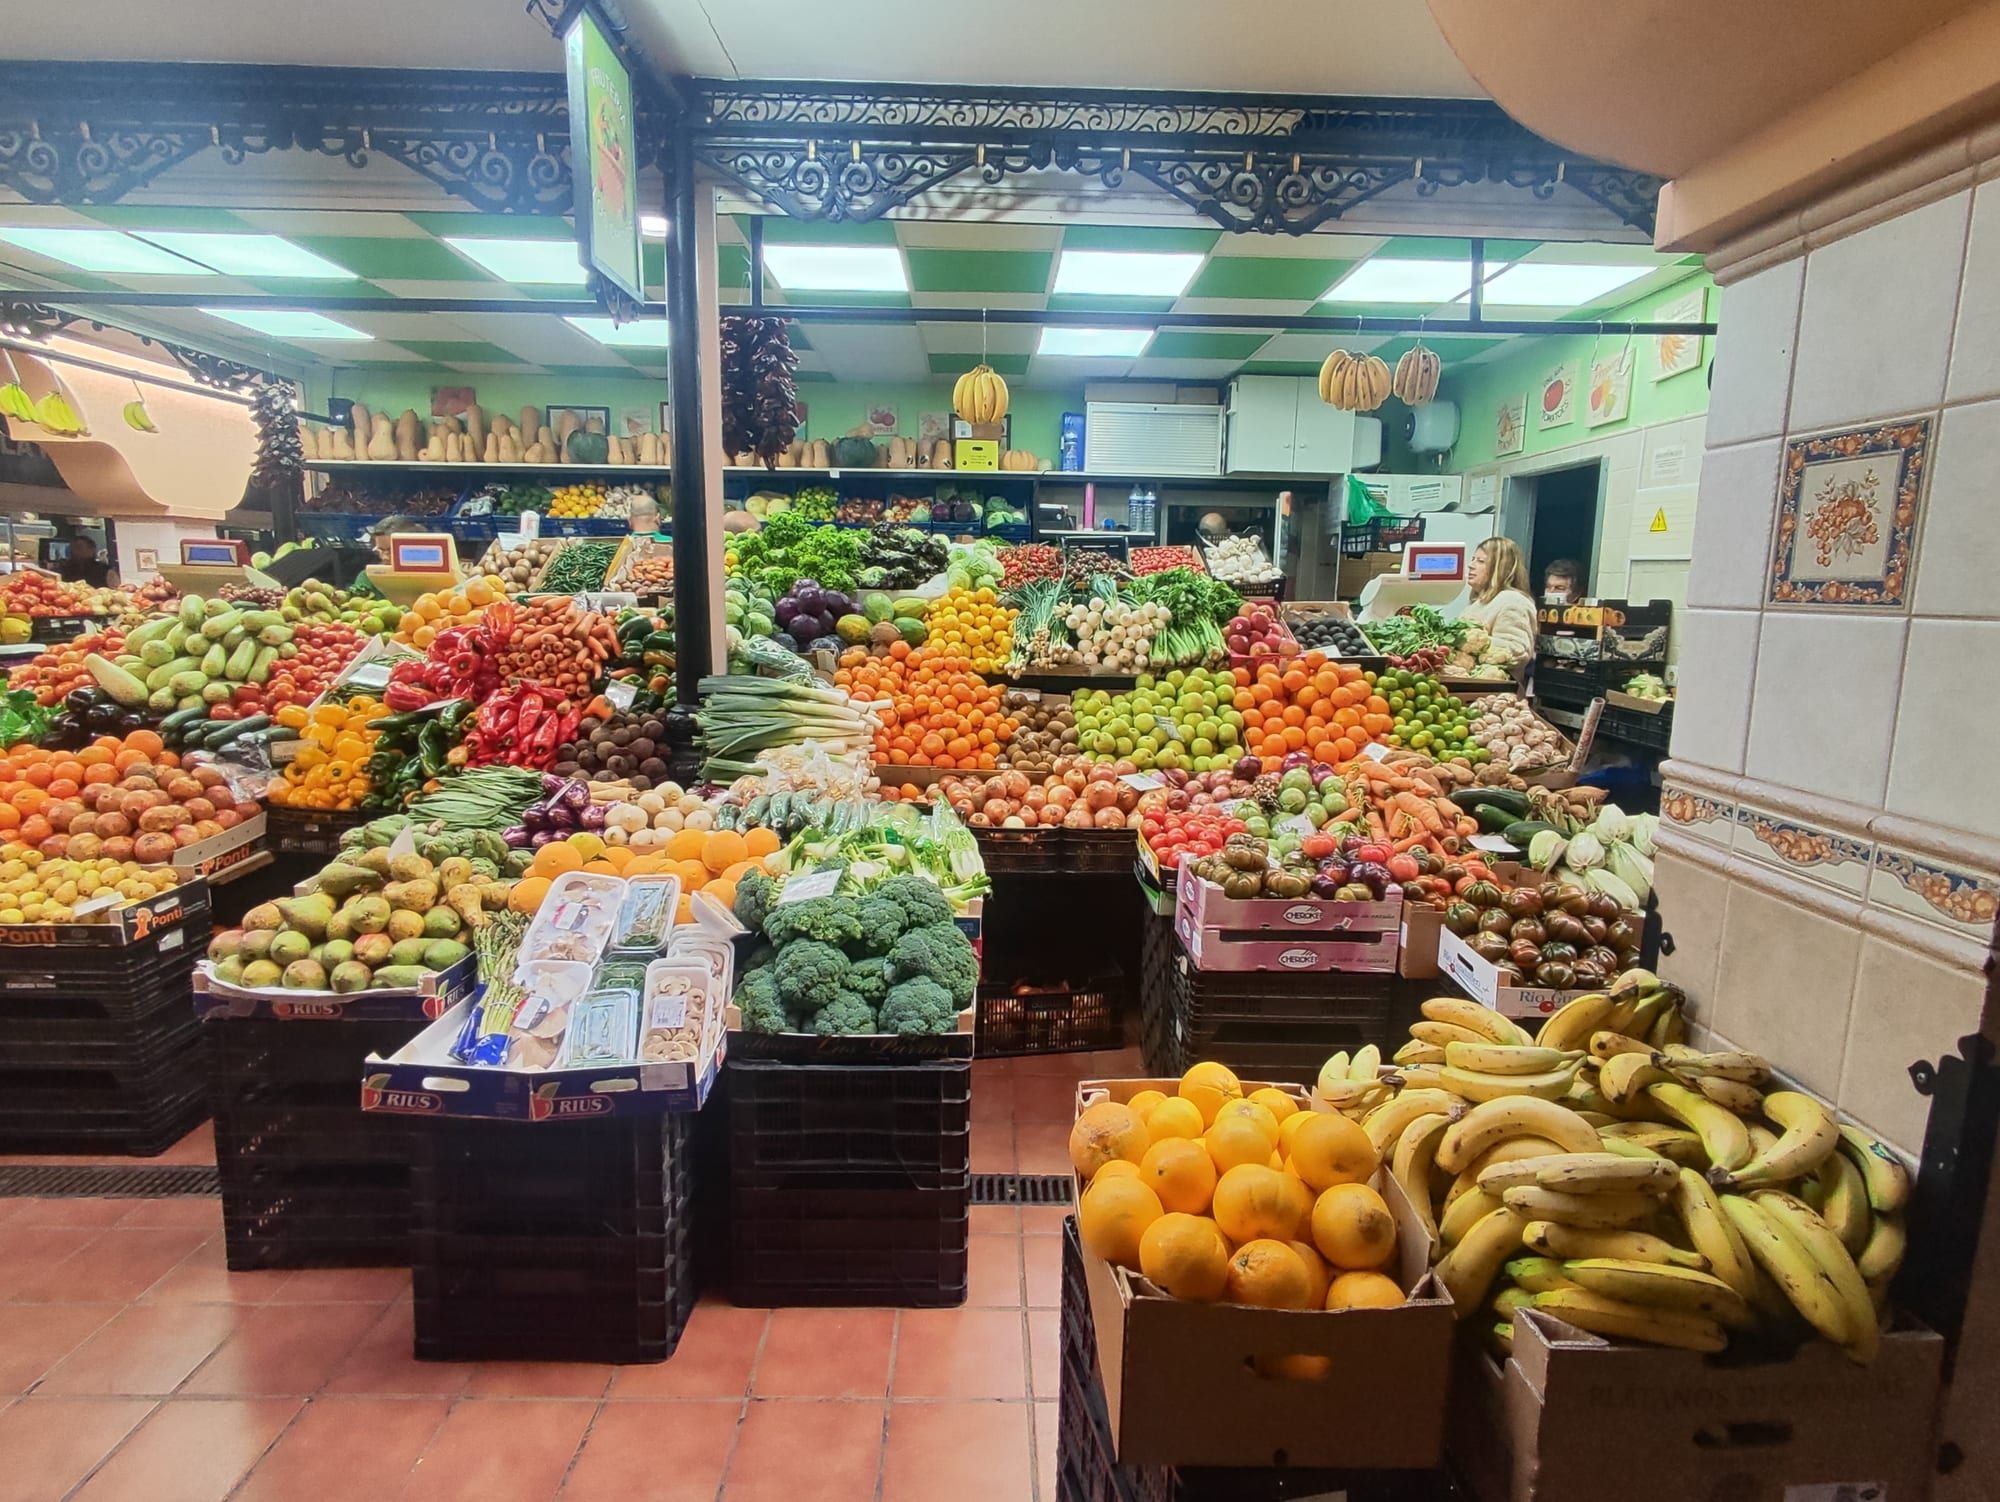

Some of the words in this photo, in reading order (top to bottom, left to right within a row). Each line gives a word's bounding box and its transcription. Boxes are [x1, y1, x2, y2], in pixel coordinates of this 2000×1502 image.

[216, 843, 249, 870] Ponti
[152, 905, 183, 928] Ponti
[0, 926, 56, 944] Ponti
[293, 1004, 334, 1015] RIUS
[386, 1094, 432, 1109] RIUS
[559, 1098, 603, 1113] RIUS
